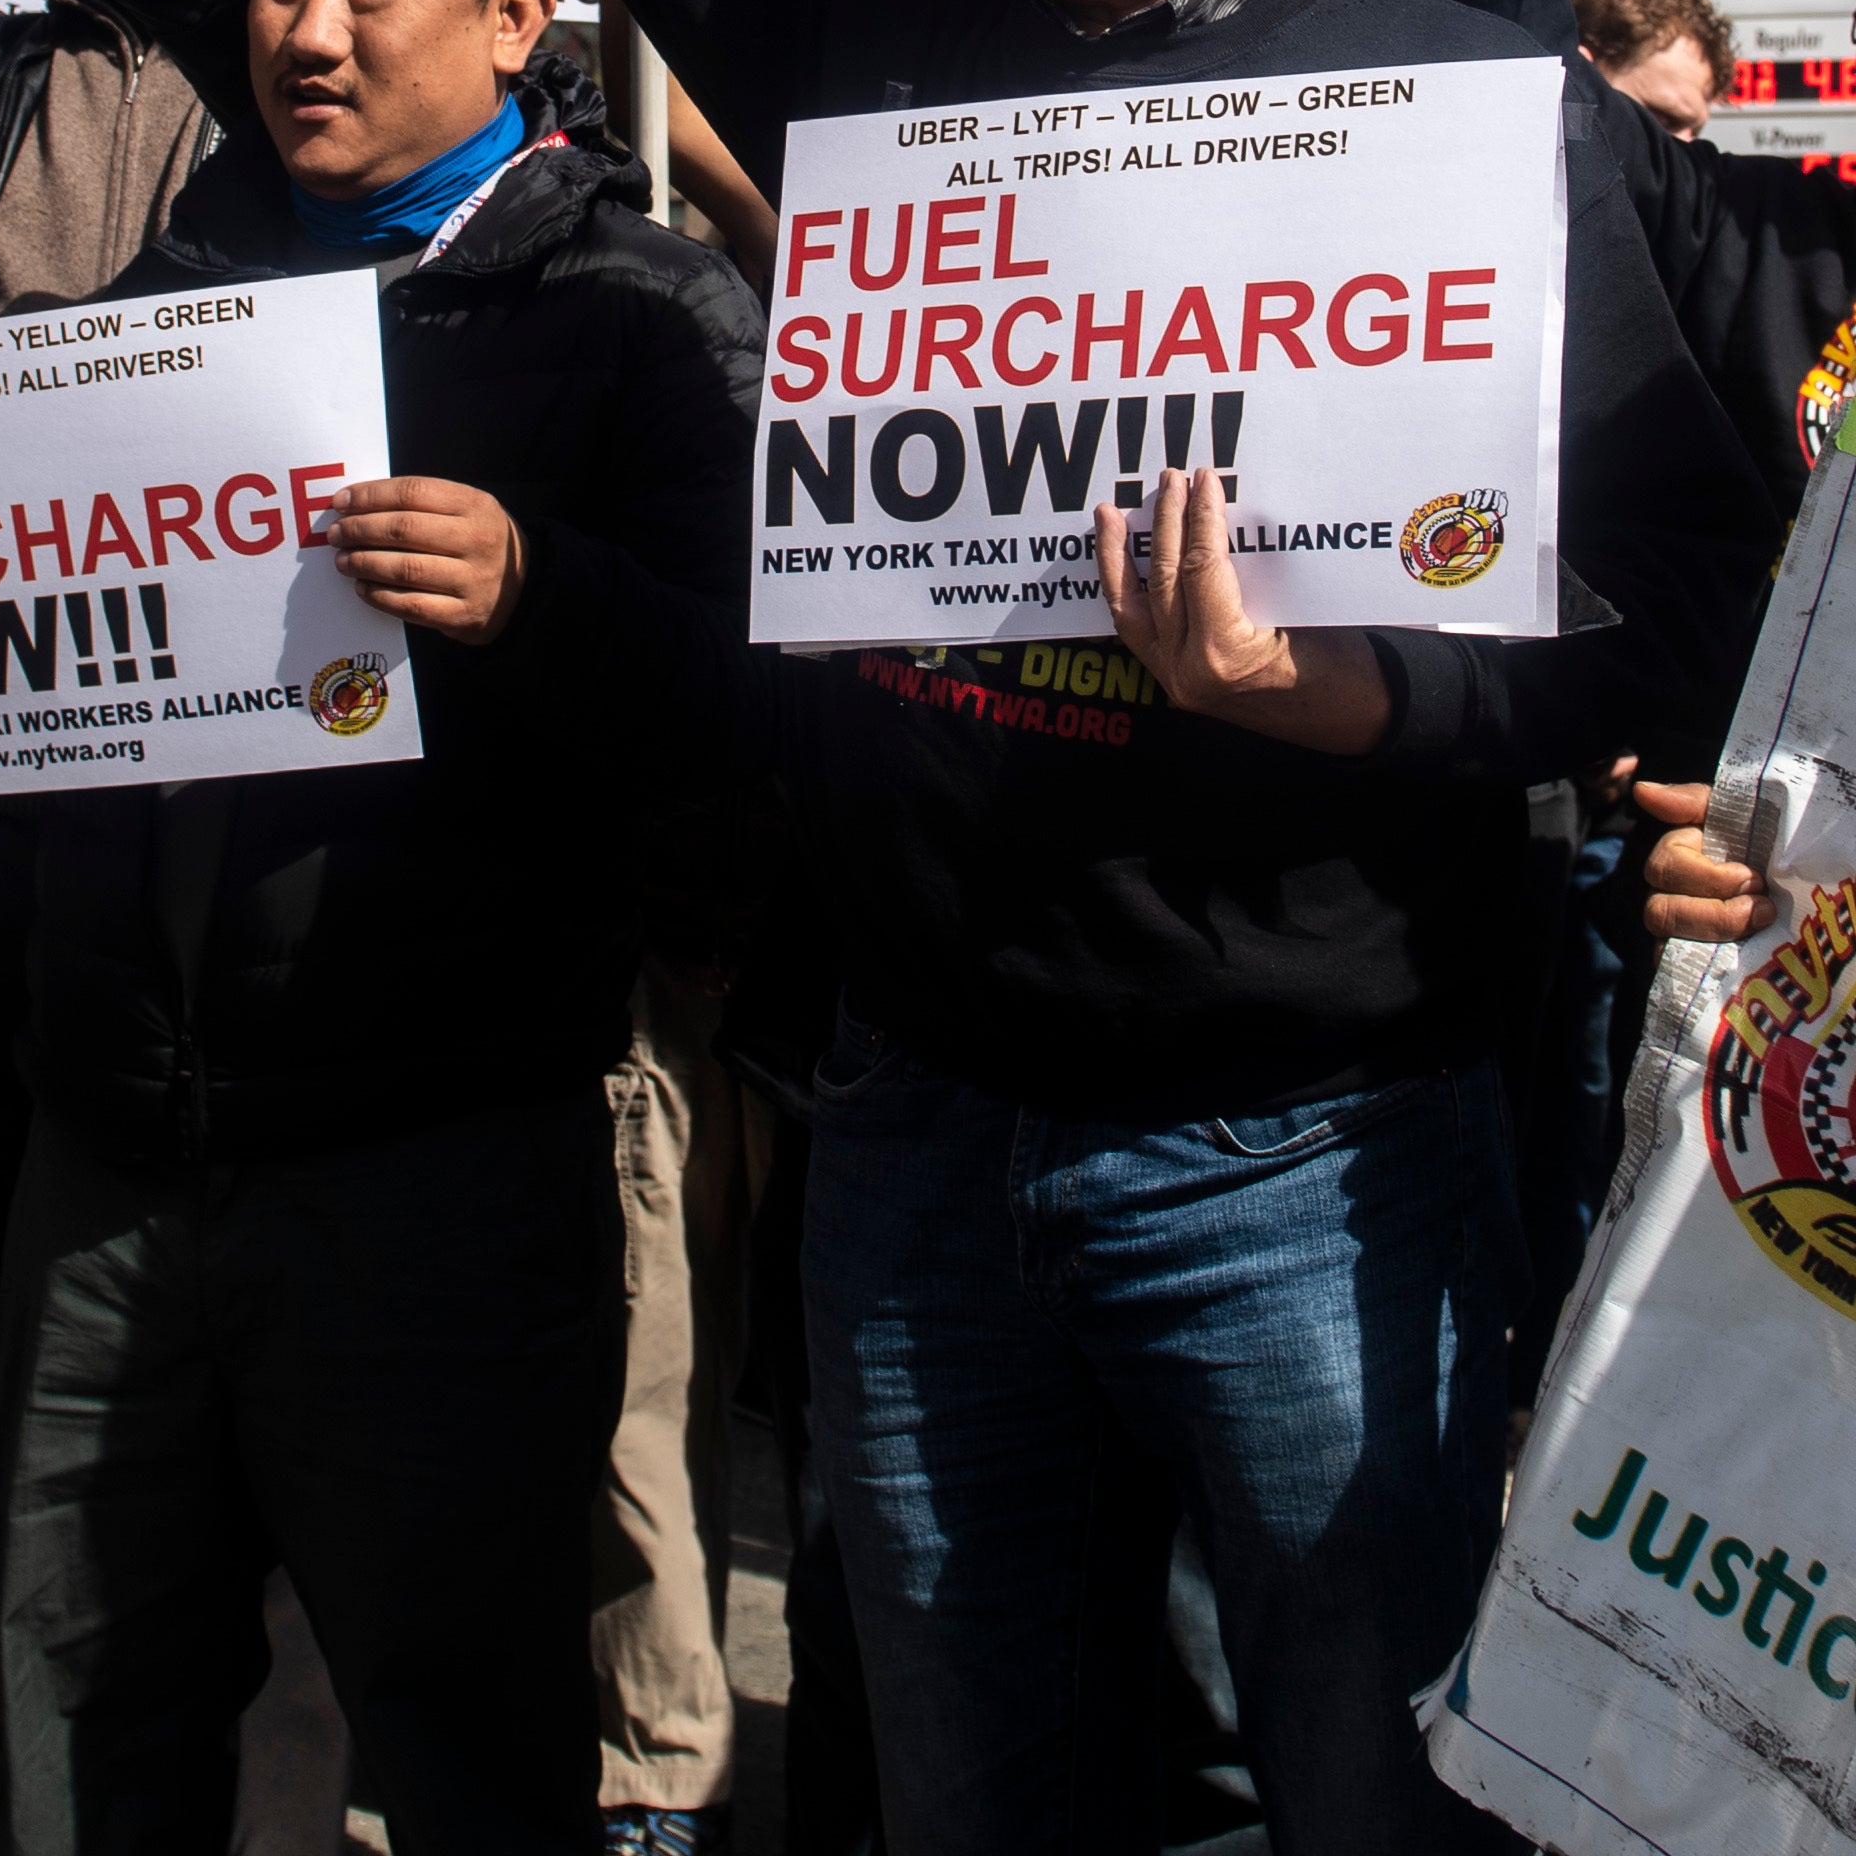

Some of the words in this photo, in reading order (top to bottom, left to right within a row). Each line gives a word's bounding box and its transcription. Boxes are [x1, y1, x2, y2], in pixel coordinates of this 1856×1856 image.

[898, 117, 978, 147] UBER
[1013, 105, 1089, 135] LYFT
[1125, 91, 1261, 124] YELLOW
[1298, 78, 1414, 111] GREEN
[946, 159, 1003, 187] ALL
[1014, 148, 1111, 180] TRIPS!
[1120, 144, 1182, 171] ALL
[1194, 130, 1347, 165] DRIVERS!
[785, 194, 1049, 298] FUEL
[8, 314, 122, 351] YELLOW
[154, 296, 254, 330] GREEN
[771, 268, 1496, 403] SURCHARGE
[19, 366, 68, 393] ALL
[75, 345, 203, 385] DRIVERS!
[1400, 493, 1460, 551] nytwa
[763, 547, 833, 574] NEW
[843, 542, 934, 571] YORK
[944, 538, 1018, 566] TAXI
[17, 701, 153, 733] WORKERS
[162, 684, 306, 721] ALLIANCE
[858, 649, 1133, 746] WWW.NYTWA.ORG
[1748, 1195, 1802, 1259] NEW
